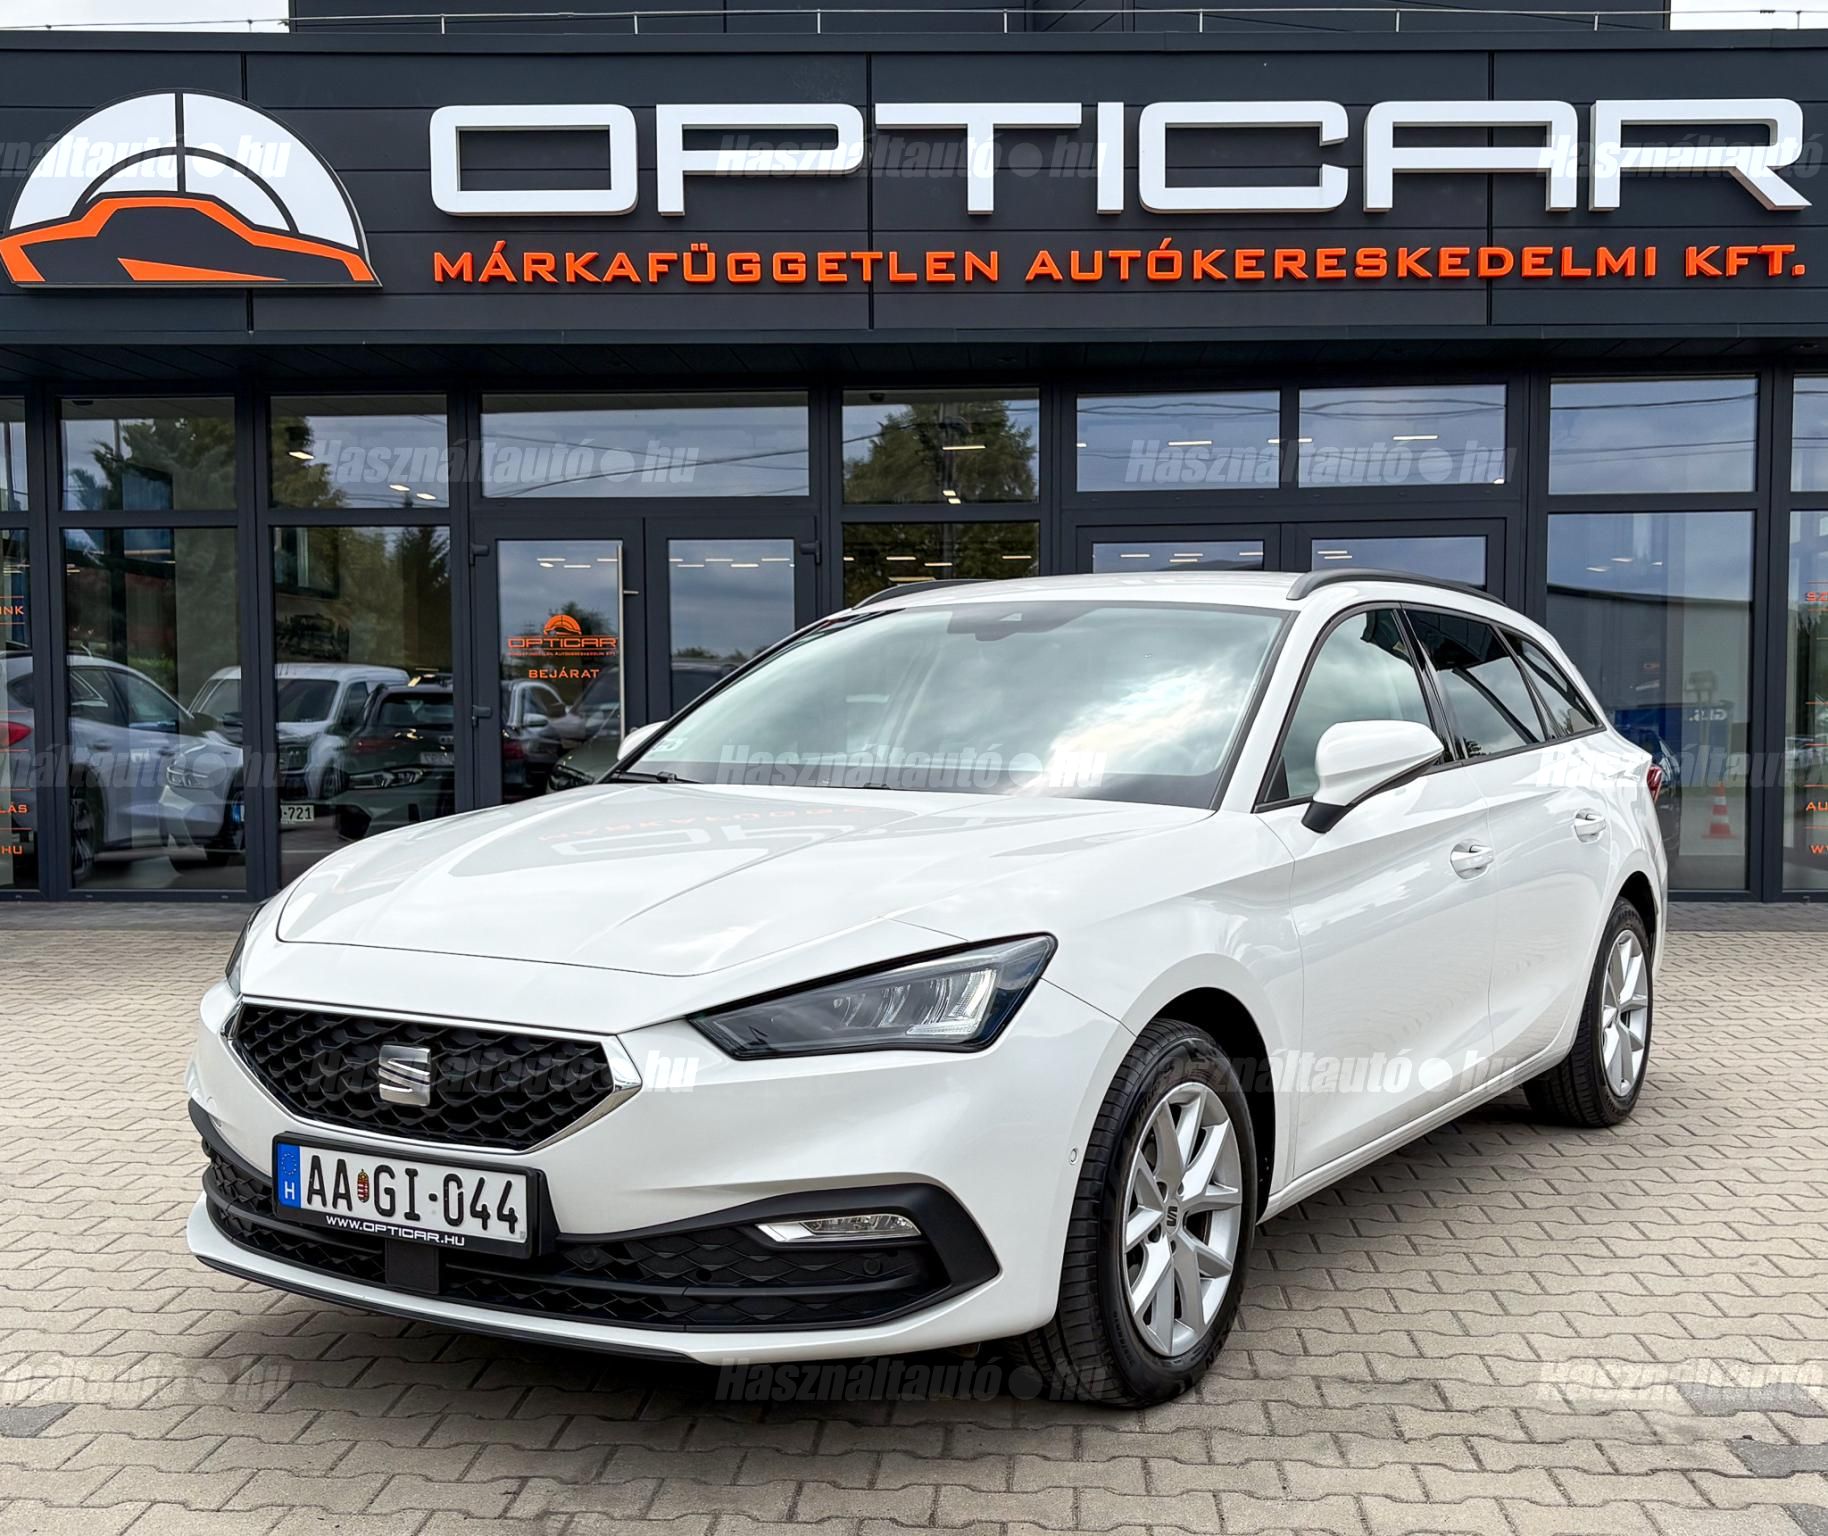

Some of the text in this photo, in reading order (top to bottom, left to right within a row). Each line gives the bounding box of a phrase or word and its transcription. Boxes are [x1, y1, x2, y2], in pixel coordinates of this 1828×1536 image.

[429, 98, 1812, 217] OPTICAR
[433, 237, 1807, 286] MÁRKAFÜGGETLEN AUTÓKERESKEDELMI KFT.
[508, 637, 617, 649] OPTICAR
[528, 666, 600, 679] BEJÁRAT
[284, 1180, 296, 1200] H
[325, 1214, 466, 1247] WWW.OPTICAR.HU
